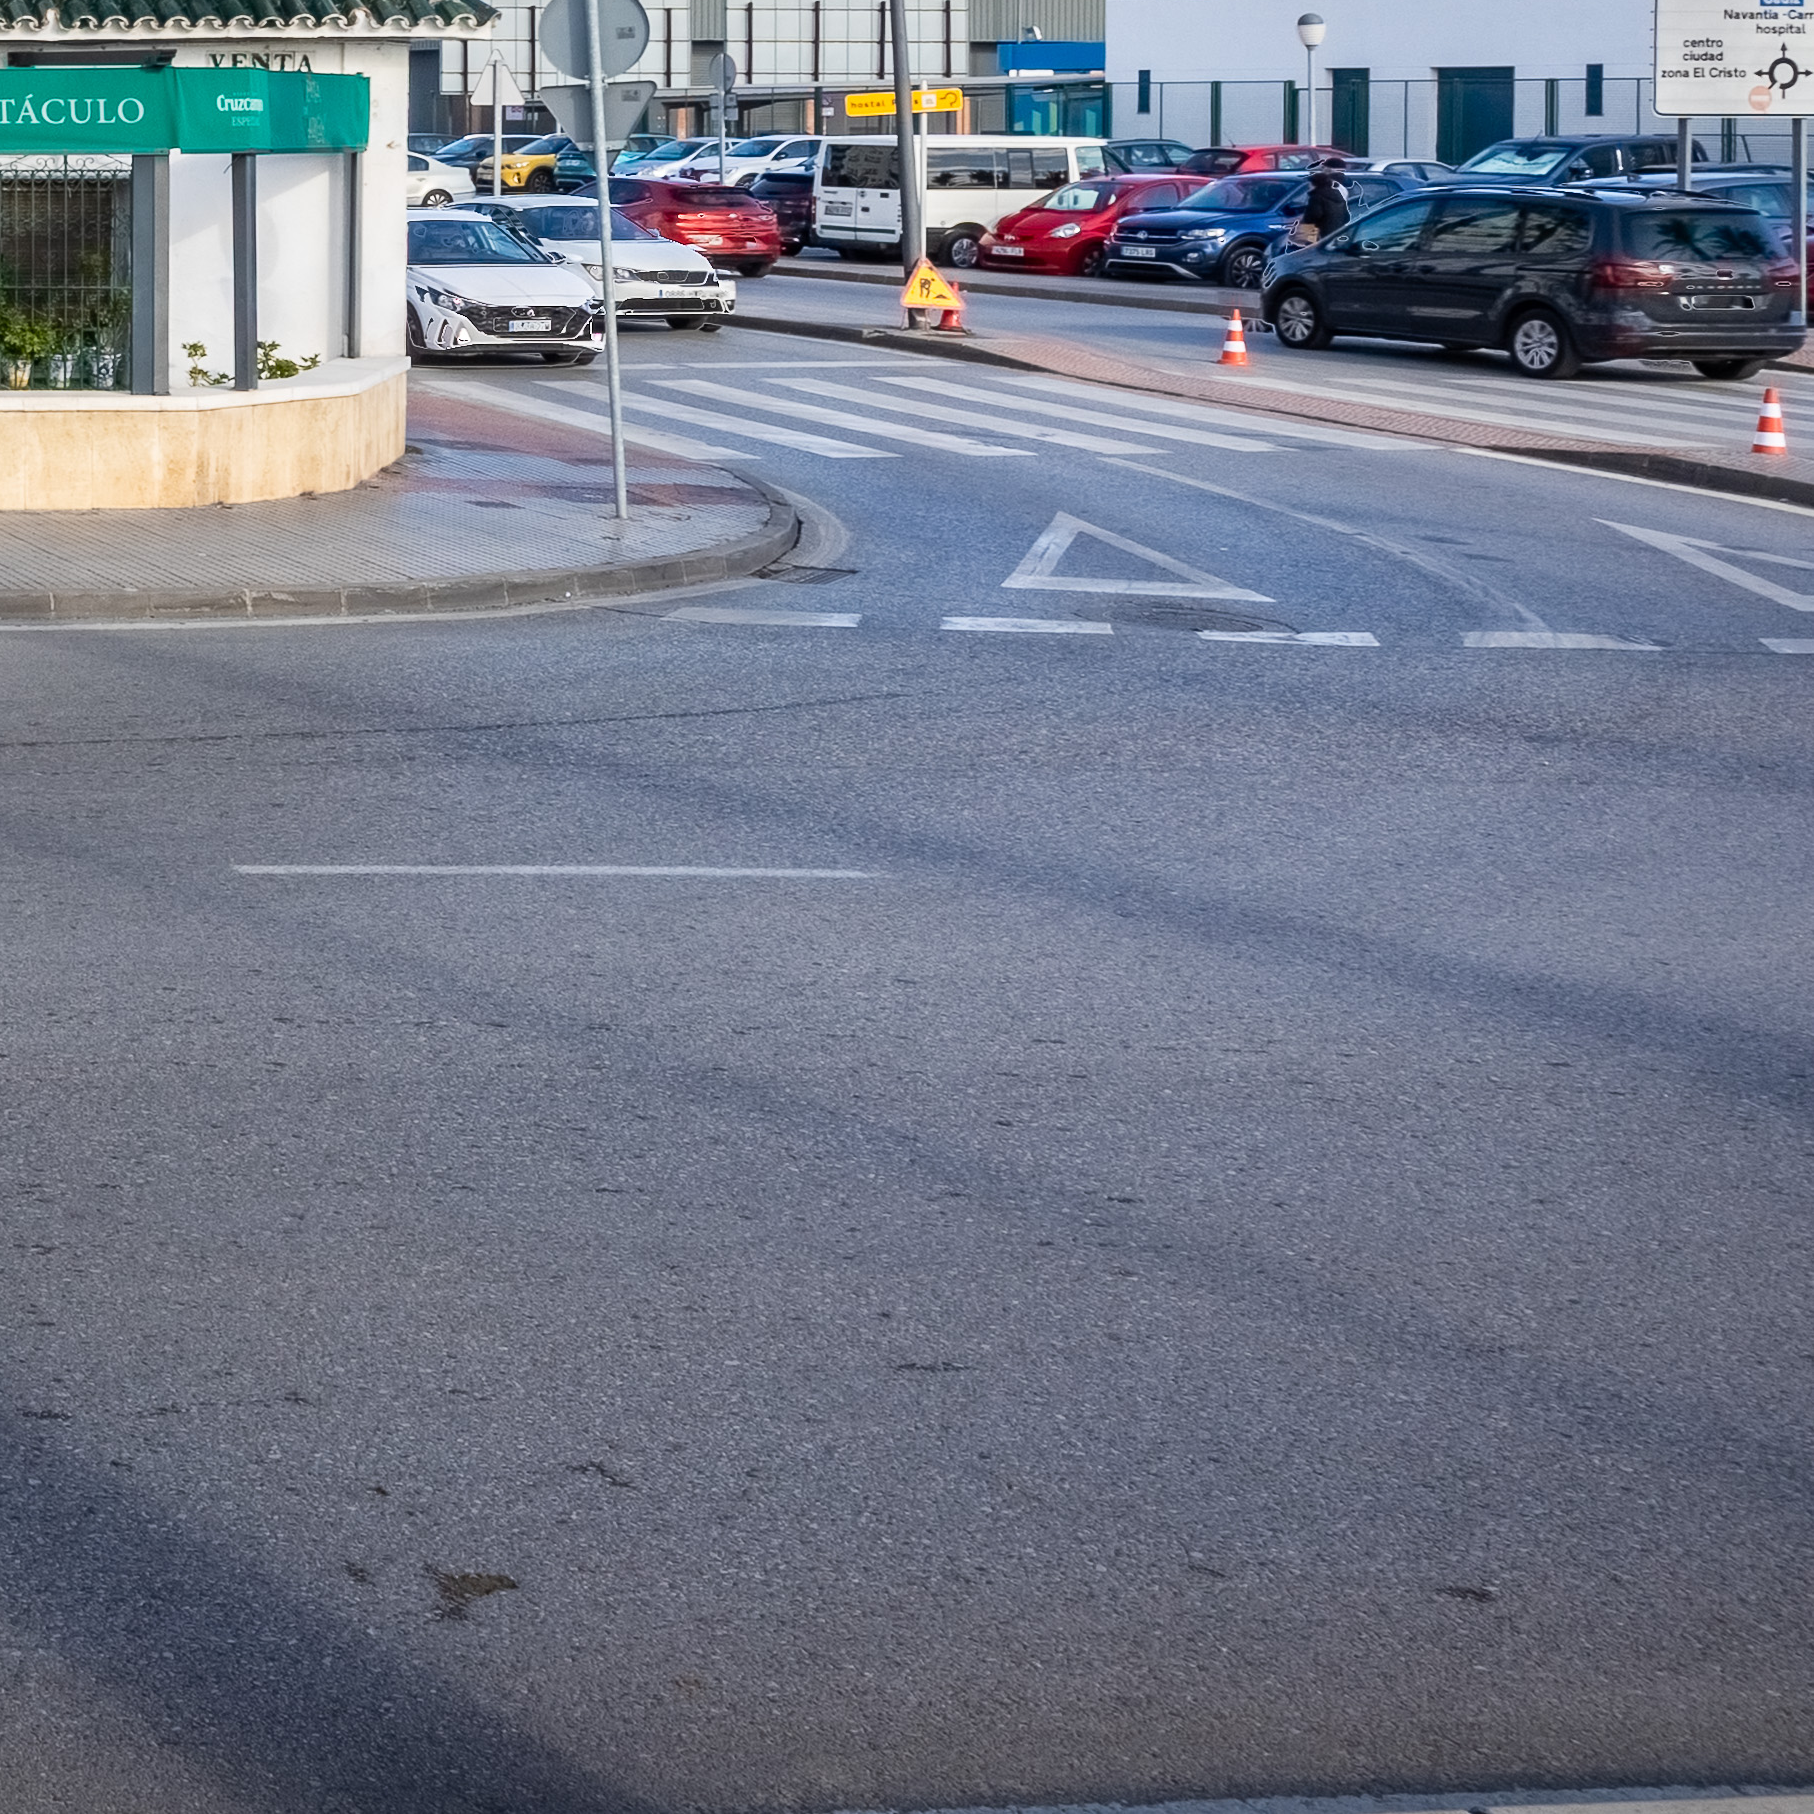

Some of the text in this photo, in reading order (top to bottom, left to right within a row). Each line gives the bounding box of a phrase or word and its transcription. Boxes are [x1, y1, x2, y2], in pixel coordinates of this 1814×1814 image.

[1724, 9, 1779, 20] Navantia
[1756, 24, 1806, 36] hospital
[1683, 38, 1724, 49] centro
[1683, 51, 1724, 62] ciudad
[209, 53, 312, 73] VENTA
[1661, 68, 1747, 79] zona El Cristo
